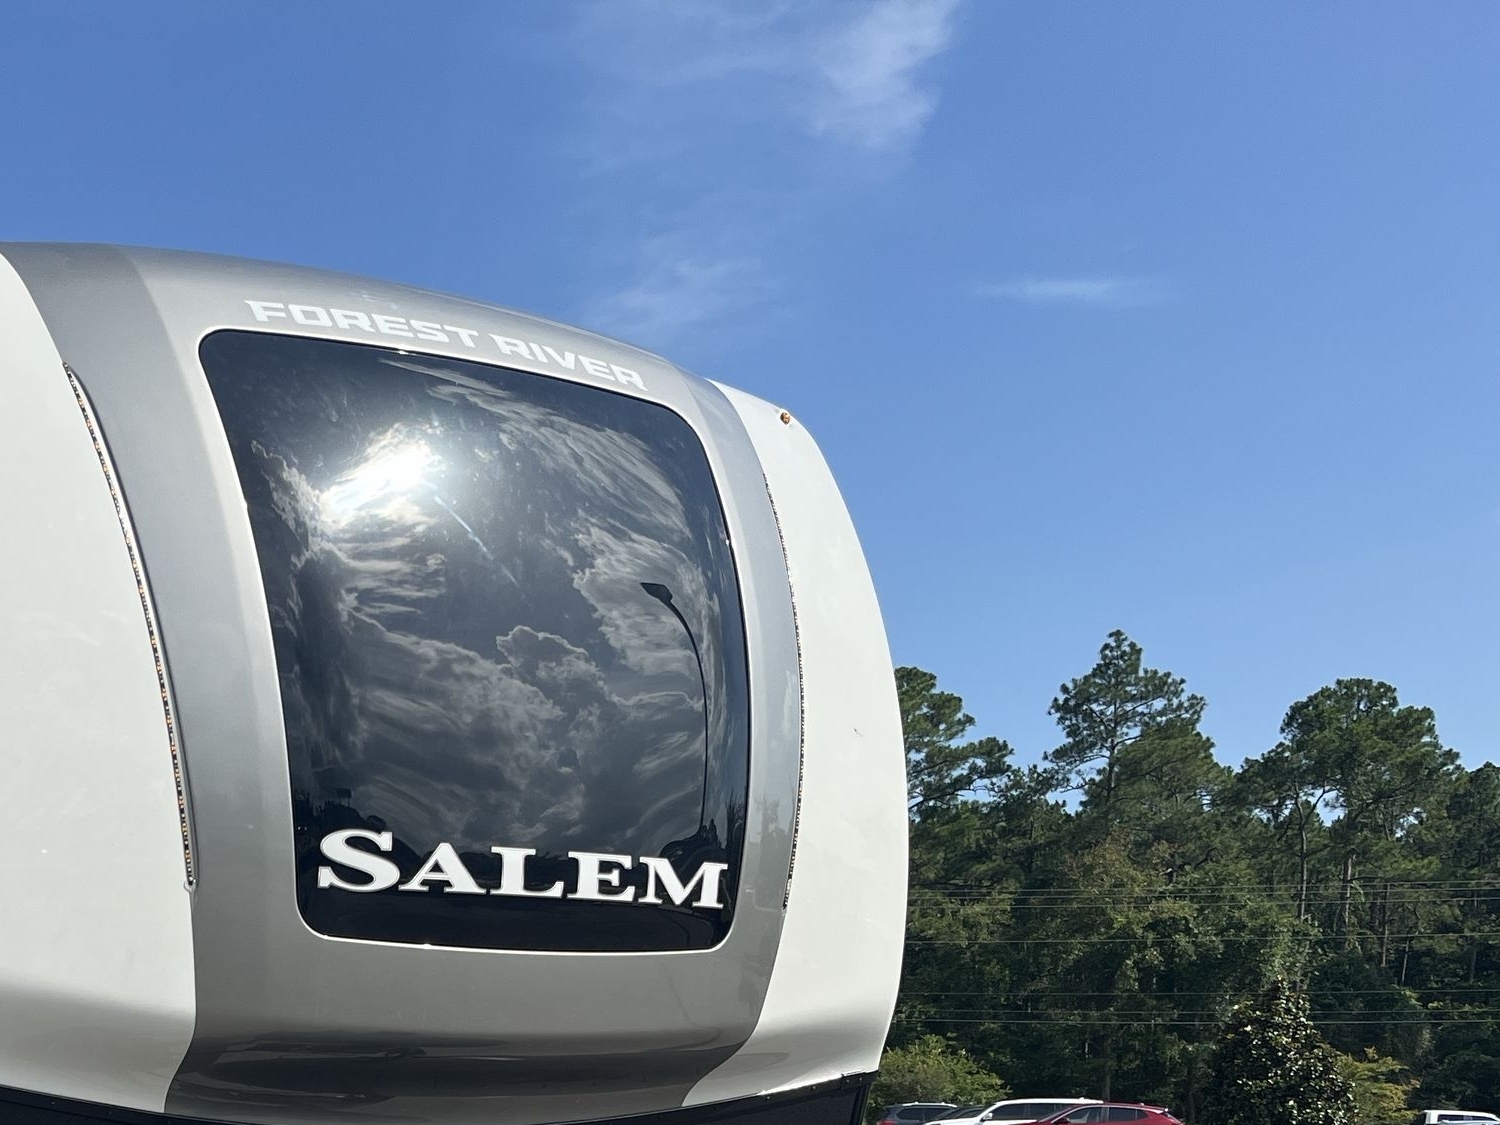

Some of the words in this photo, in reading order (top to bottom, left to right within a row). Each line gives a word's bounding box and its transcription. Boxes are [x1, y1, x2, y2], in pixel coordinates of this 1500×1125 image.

[243, 299, 479, 349] FOREST
[488, 332, 649, 392] RIVER
[317, 828, 729, 909] SALEM
